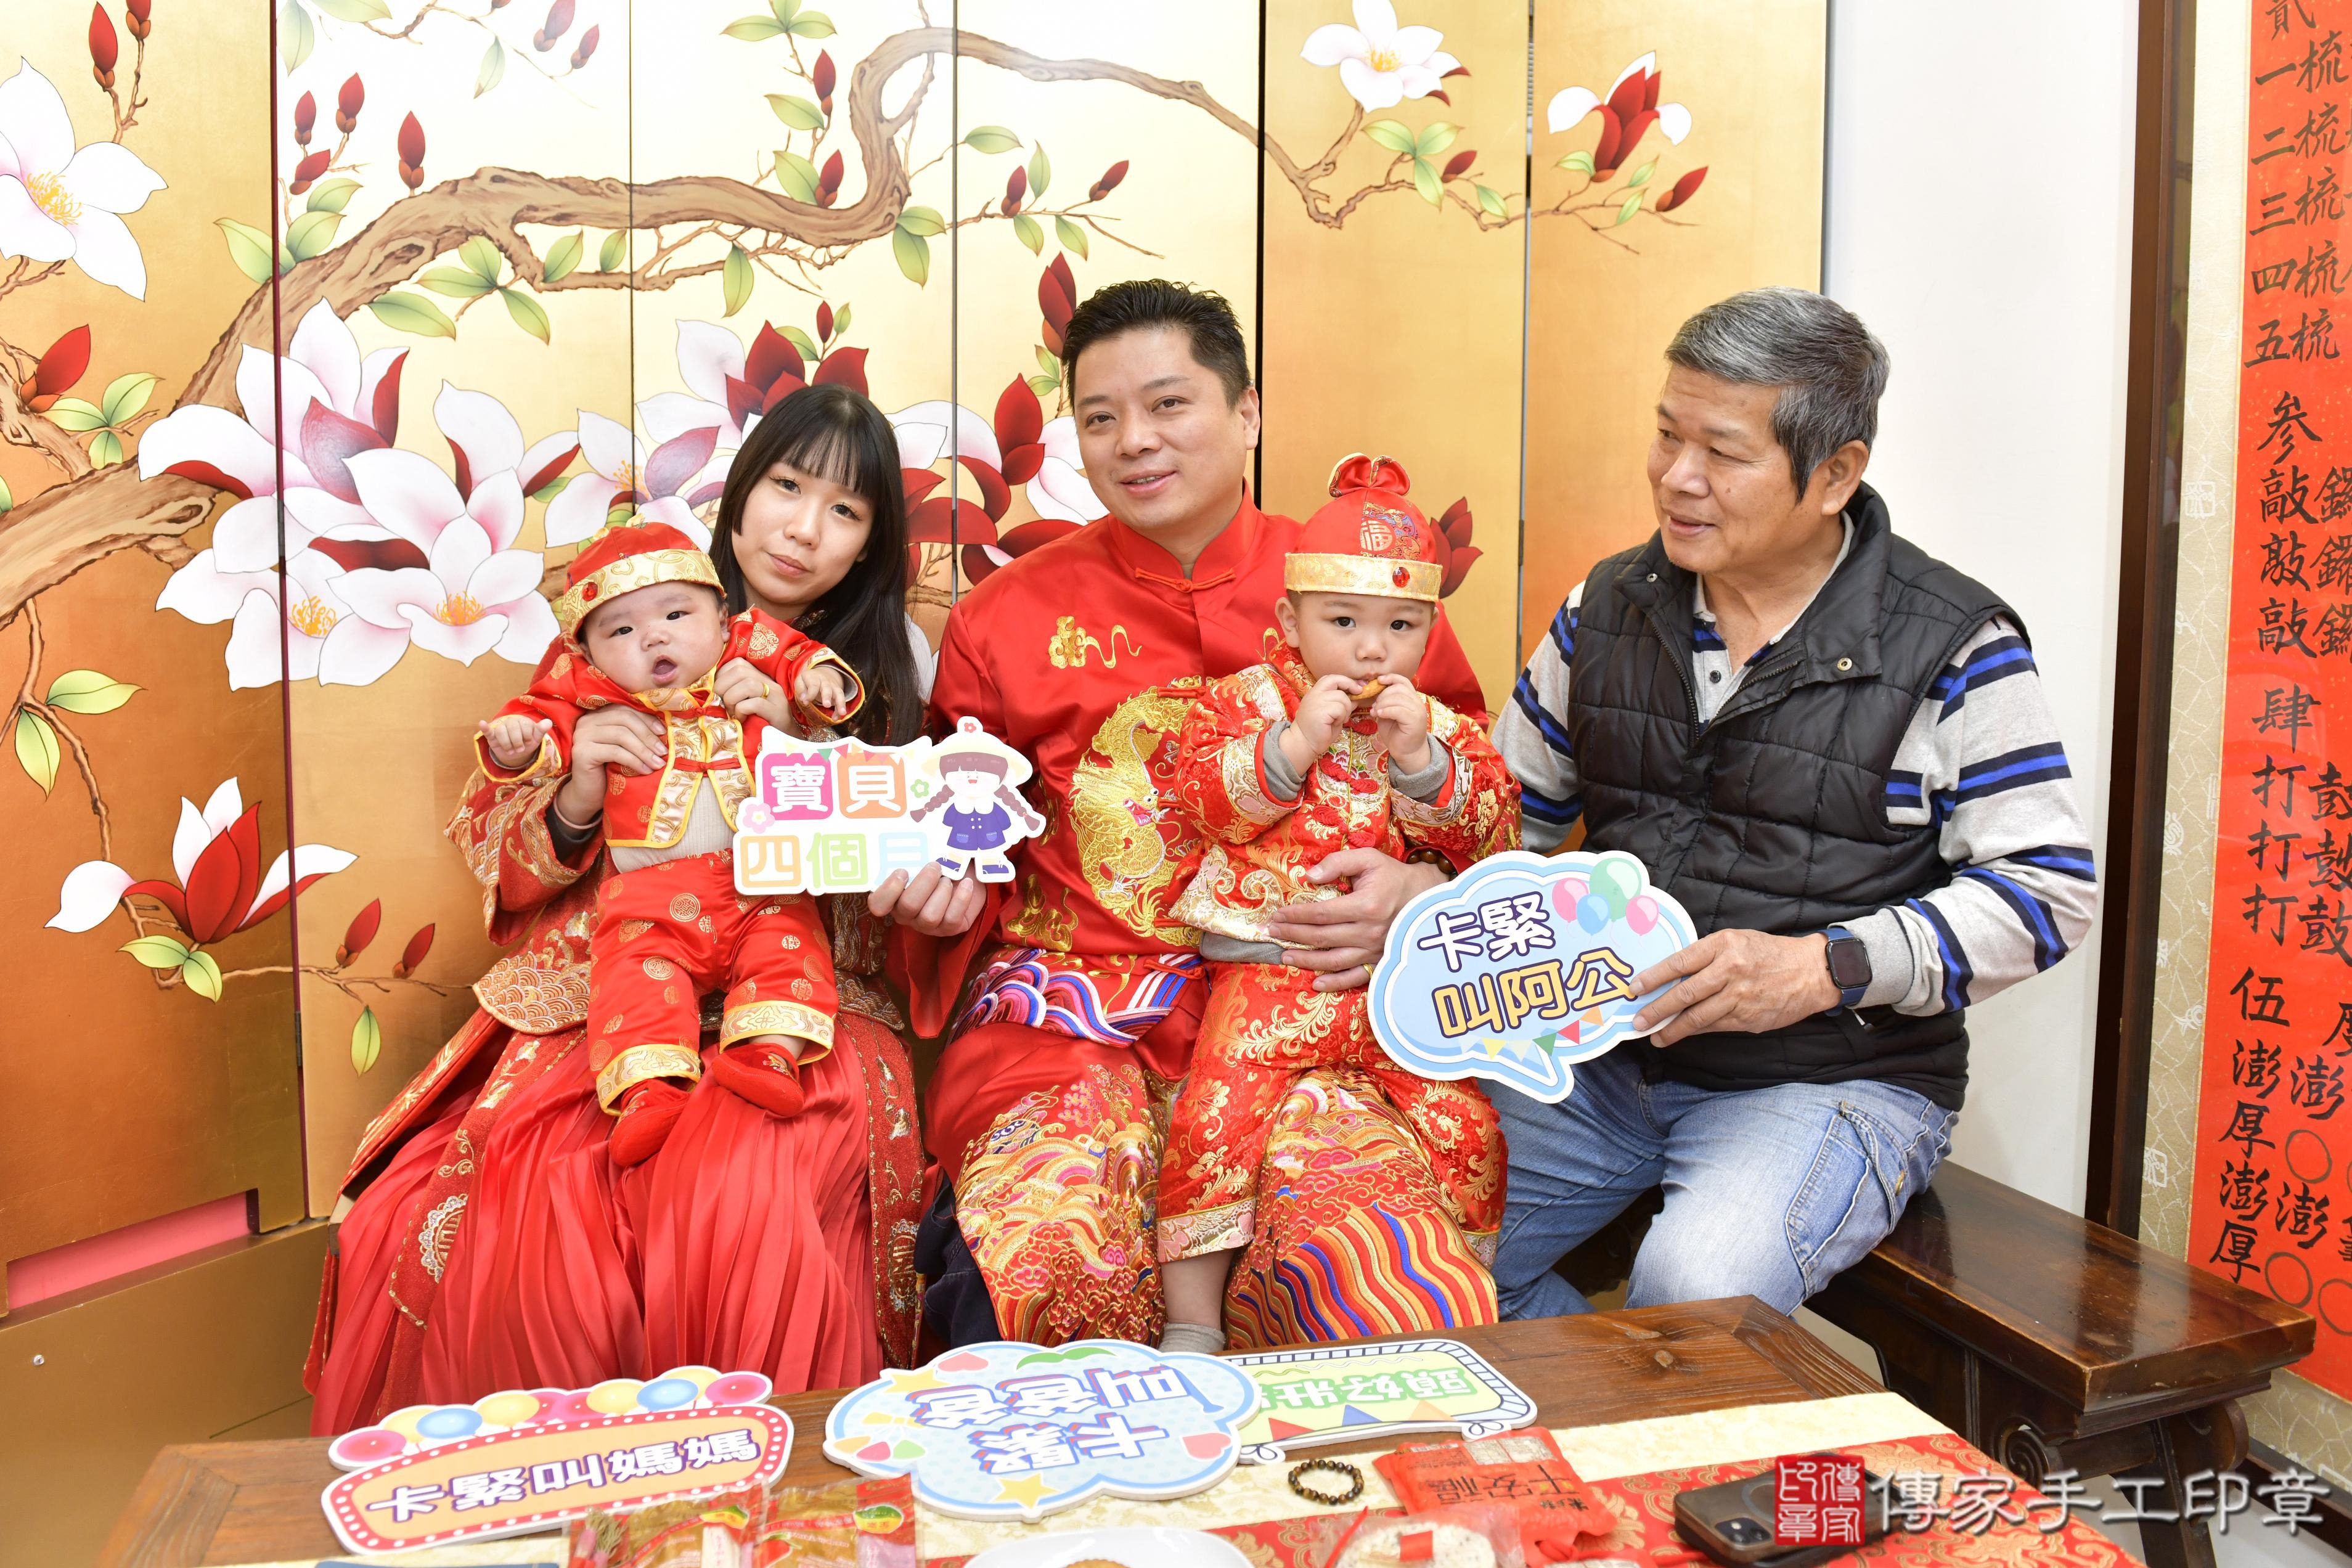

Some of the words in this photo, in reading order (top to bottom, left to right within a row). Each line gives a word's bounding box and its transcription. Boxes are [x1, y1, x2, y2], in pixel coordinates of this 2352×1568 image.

[2251, 102, 2352, 165] 二梳
[2249, 166, 2352, 236] 三梳
[2251, 240, 2352, 299] 四梳
[770, 762, 901, 814] 寶貝
[740, 832, 929, 889] 四個月
[1418, 891, 1556, 973] 卡緊
[1432, 947, 1637, 1038] 叫阿公
[2230, 966, 2290, 1027] 伍
[910, 1366, 1188, 1429] 叫爸爸
[1262, 1368, 1476, 1408] 頭好壯
[970, 1413, 1169, 1474] 卡緊
[366, 1428, 763, 1524] 卡緊叫媽媽
